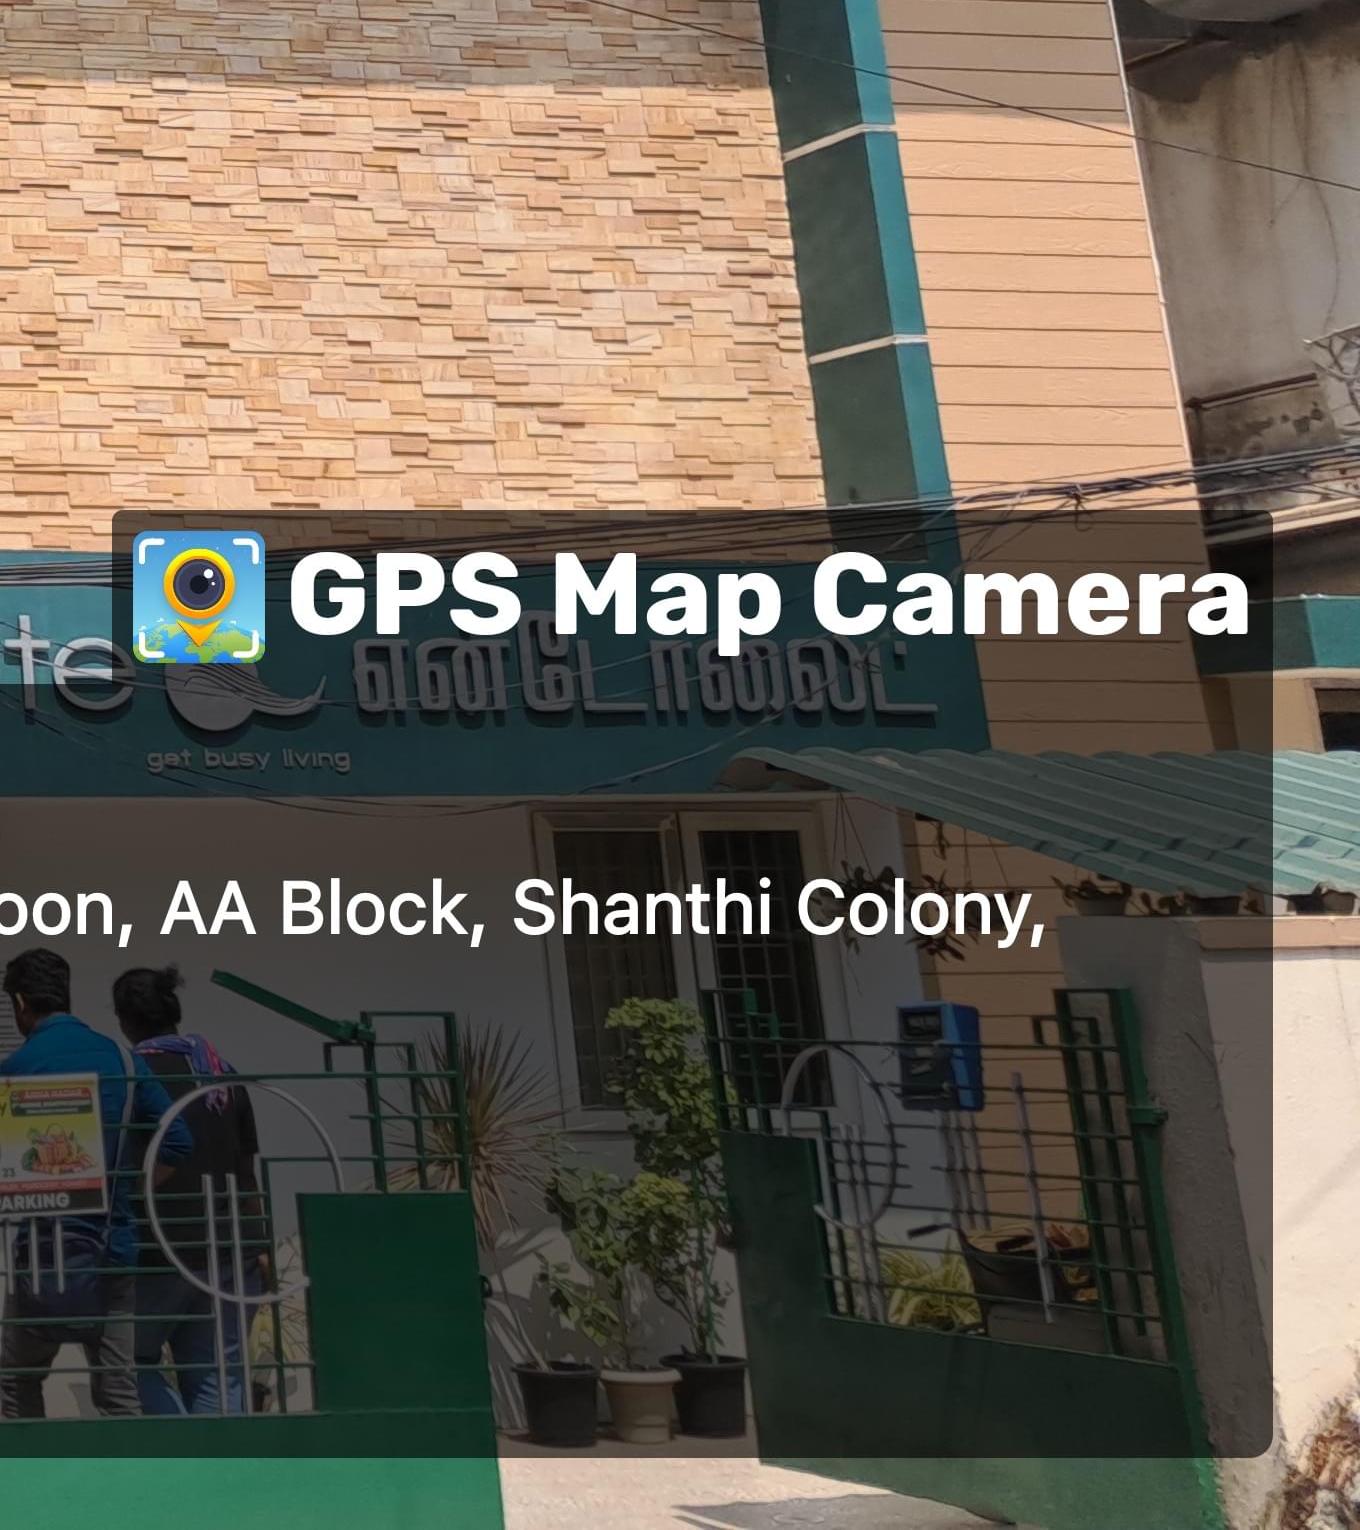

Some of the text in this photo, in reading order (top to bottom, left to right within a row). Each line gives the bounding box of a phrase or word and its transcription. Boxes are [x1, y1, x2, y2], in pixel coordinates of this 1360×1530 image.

[147, 749, 351, 773] get busy living
[3, 1167, 16, 1178] 23
